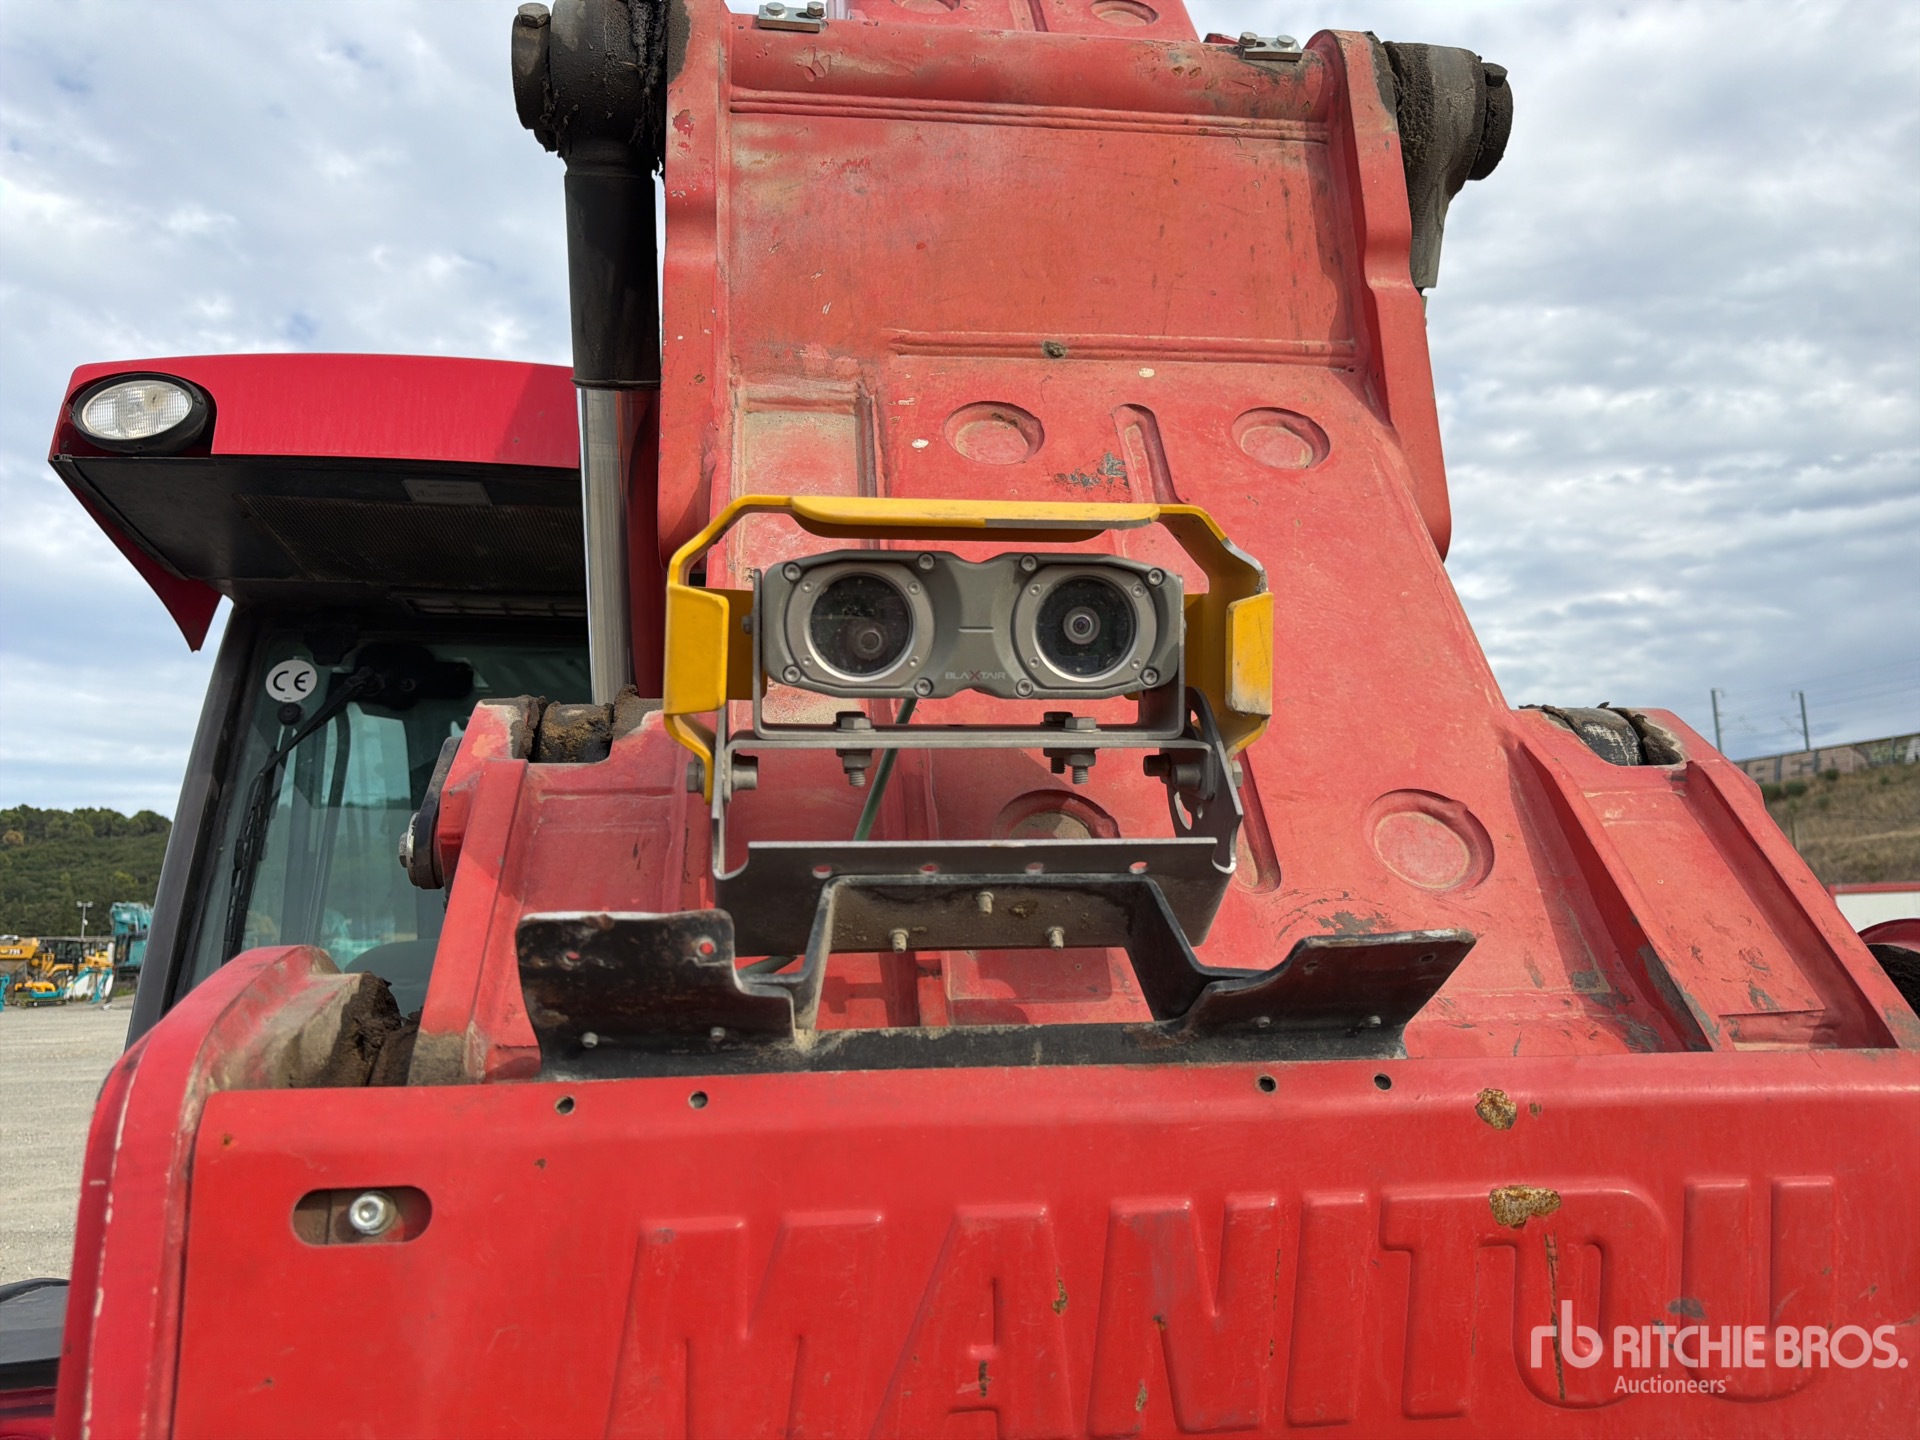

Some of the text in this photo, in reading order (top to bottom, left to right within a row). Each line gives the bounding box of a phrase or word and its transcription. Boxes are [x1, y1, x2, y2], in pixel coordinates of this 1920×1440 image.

[272, 670, 311, 693] CE
[944, 669, 1006, 681] BLAXTAIR
[600, 1174, 1838, 1440] MANITOU
